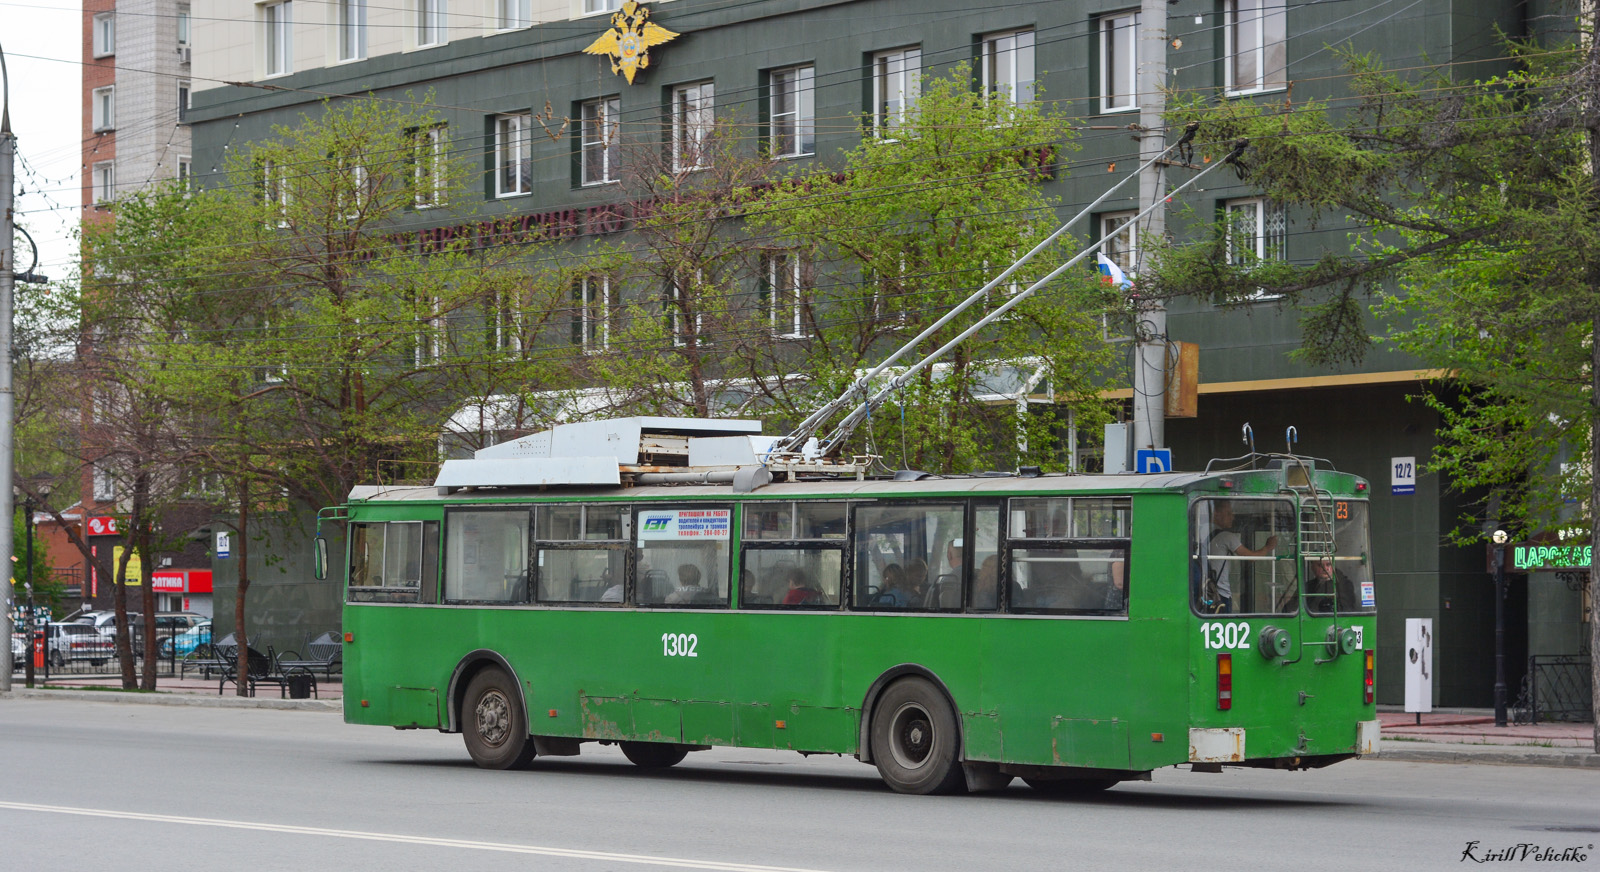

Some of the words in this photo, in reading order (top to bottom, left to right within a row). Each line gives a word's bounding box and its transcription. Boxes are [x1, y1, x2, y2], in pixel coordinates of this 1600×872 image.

[587, 204, 625, 235] ПО
[1394, 462, 1412, 479] 12/2
[1336, 502, 1348, 519] 23
[1514, 545, 1592, 569] ЦАРСКАЯ
[661, 633, 698, 657] 1302
[1200, 622, 1250, 649] 1302
